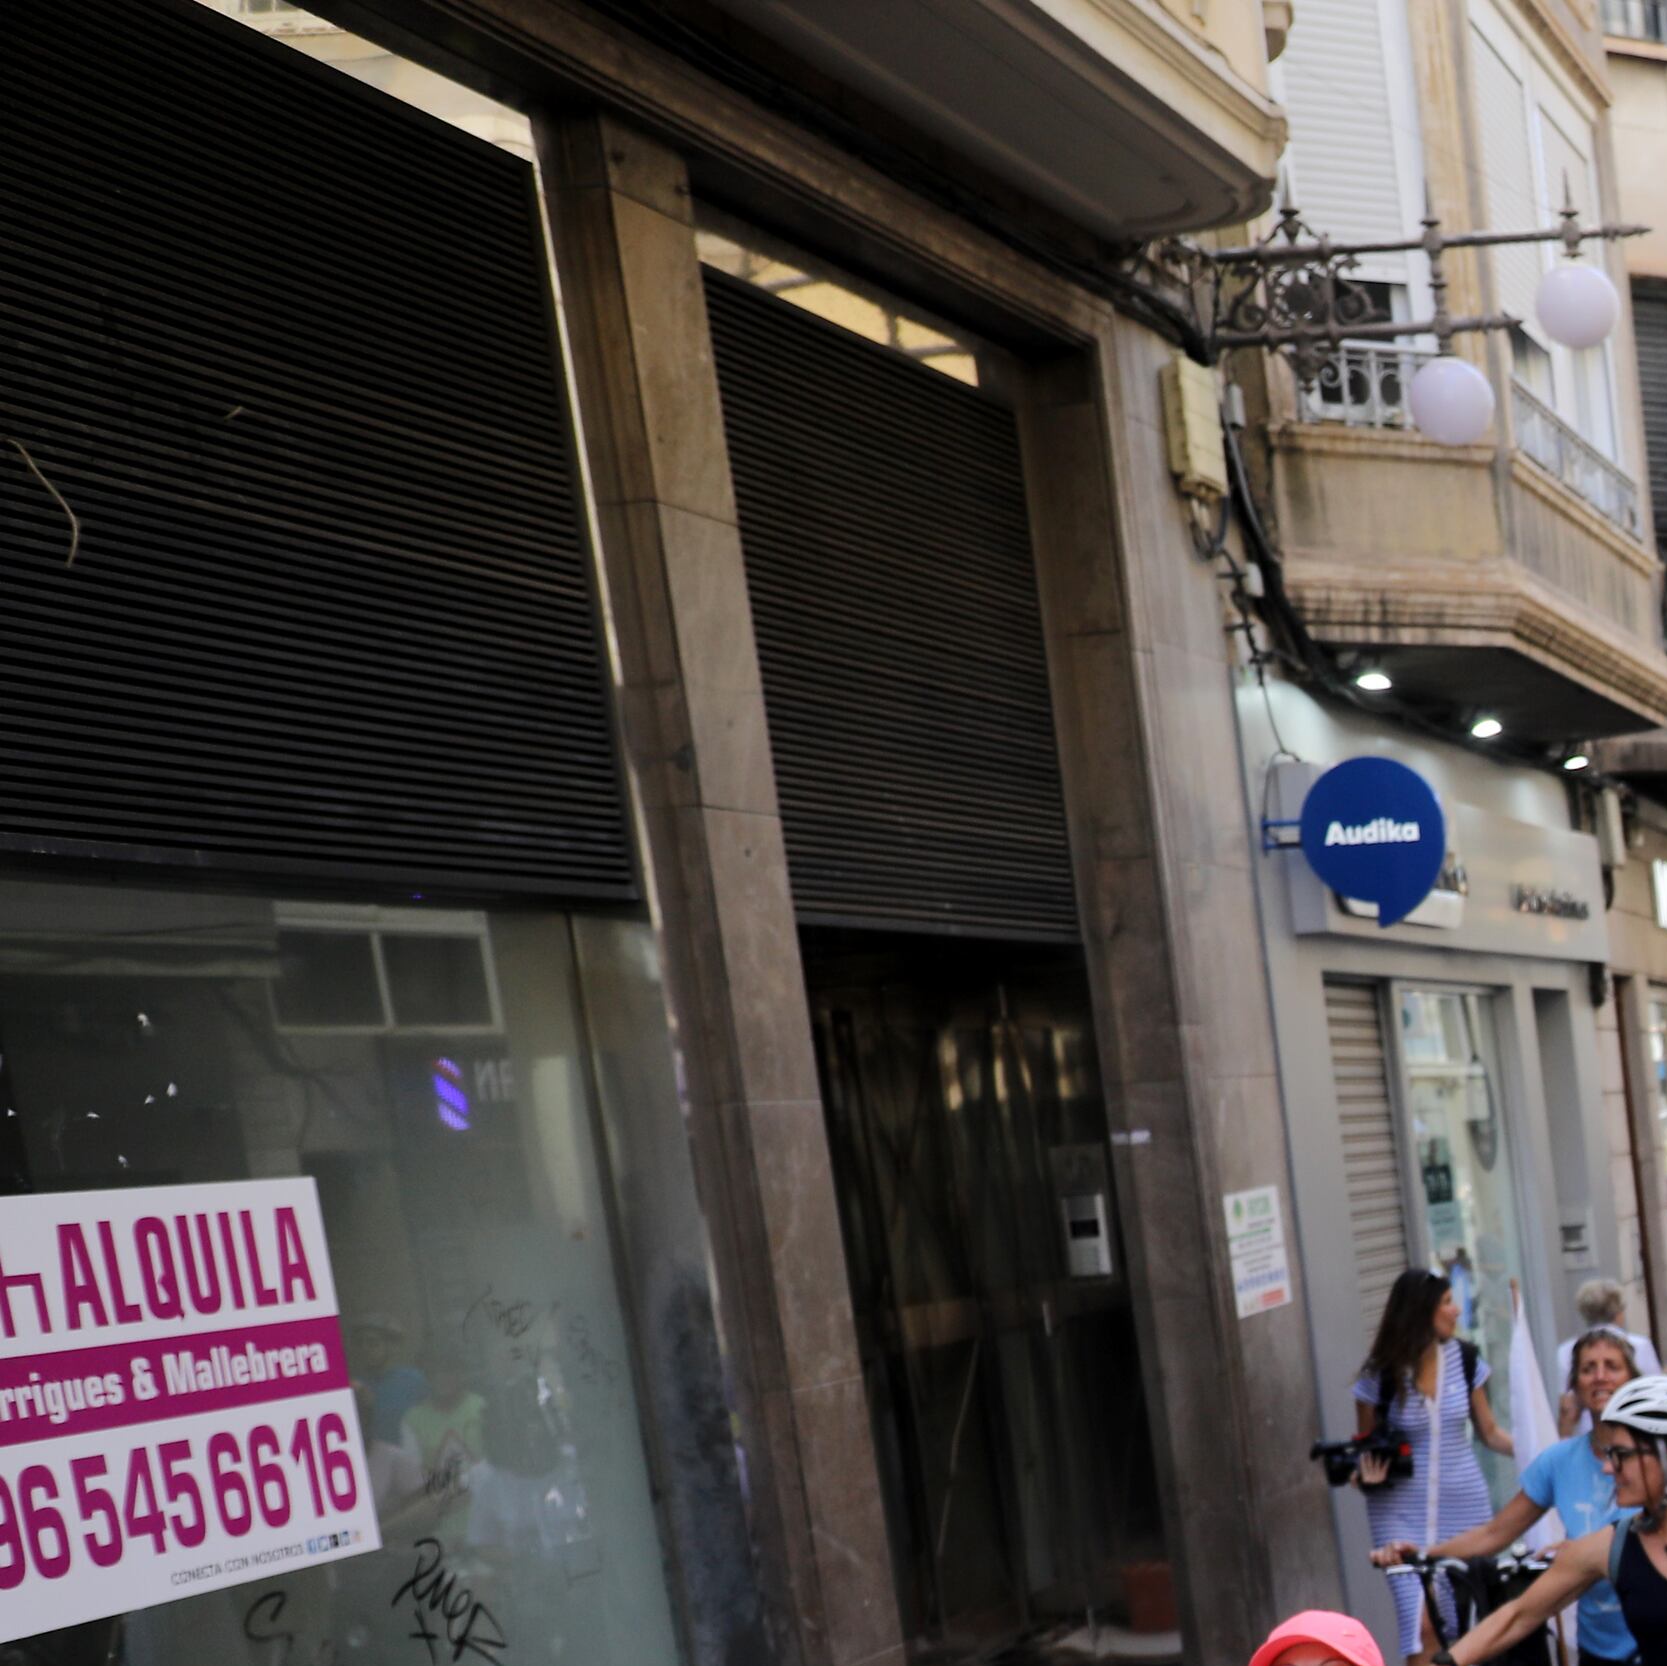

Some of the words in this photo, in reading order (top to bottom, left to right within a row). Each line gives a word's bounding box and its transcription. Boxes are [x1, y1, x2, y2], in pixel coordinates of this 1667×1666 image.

[1325, 816, 1420, 847] Audika
[57, 1207, 318, 1329] ALQUILA
[132, 1356, 159, 1402] &
[162, 1341, 330, 1397] Mallebrera
[170, 1563, 223, 1587] CONECTA
